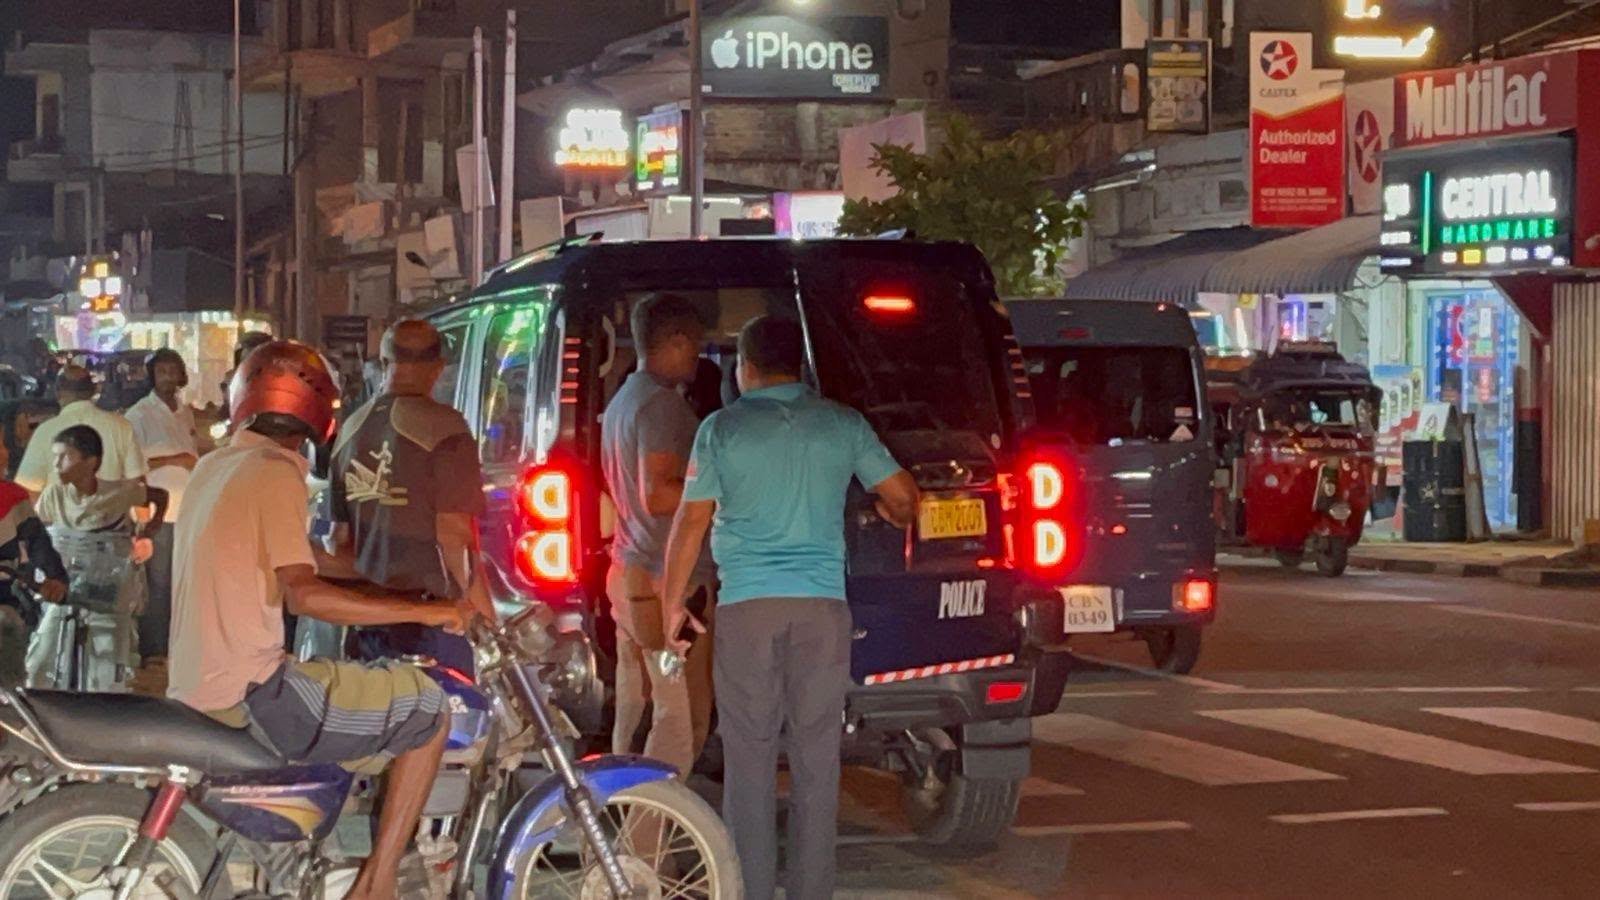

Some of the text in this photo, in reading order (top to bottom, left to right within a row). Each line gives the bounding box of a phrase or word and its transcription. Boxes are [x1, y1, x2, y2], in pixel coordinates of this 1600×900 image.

[746, 31, 874, 70] iPhone
[1260, 88, 1297, 98] CALTEX
[1406, 65, 1548, 141] Multilac
[1259, 129, 1336, 145] Authorized
[1260, 148, 1307, 164] Dealer
[1442, 169, 1557, 220] CENTRAL
[1442, 218, 1555, 244] HARDWARE
[938, 579, 987, 619] POLICE
